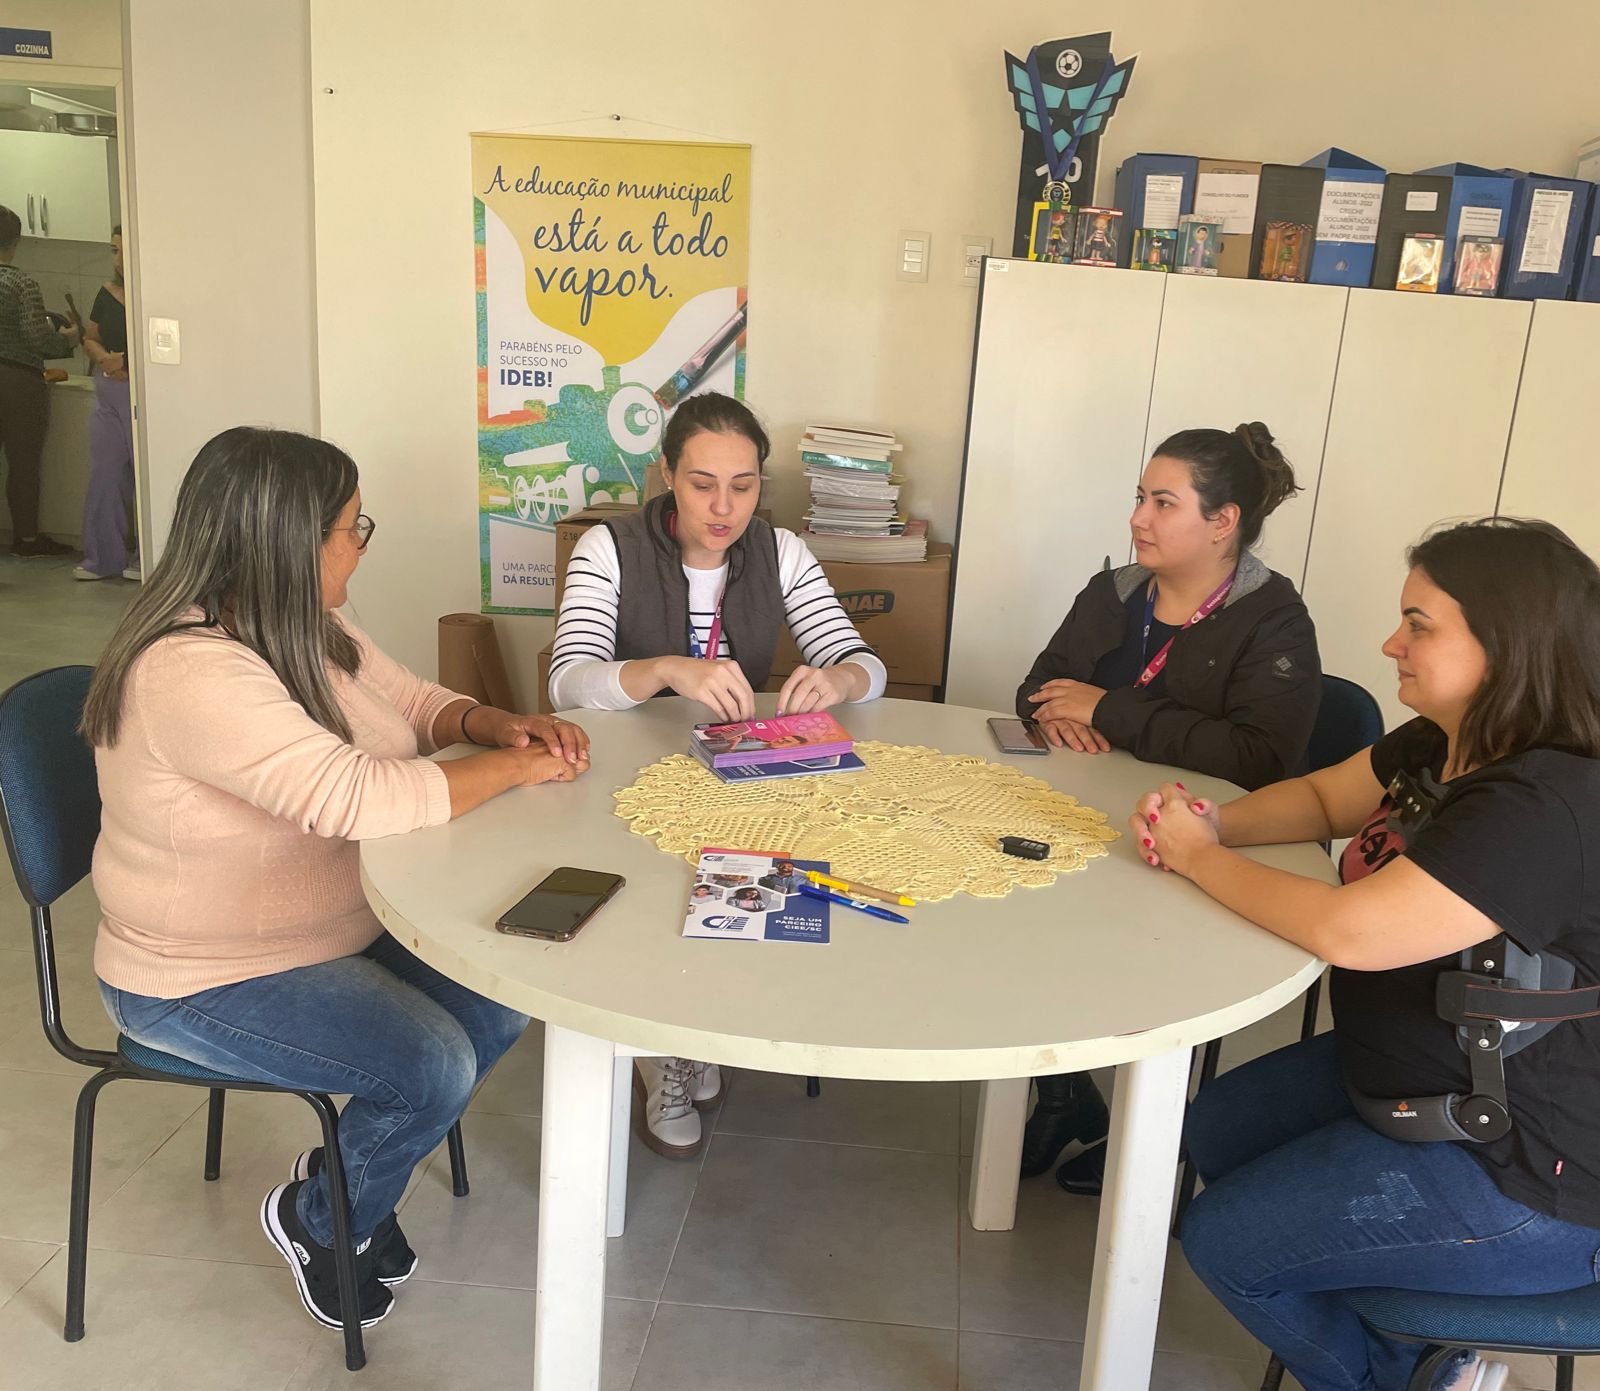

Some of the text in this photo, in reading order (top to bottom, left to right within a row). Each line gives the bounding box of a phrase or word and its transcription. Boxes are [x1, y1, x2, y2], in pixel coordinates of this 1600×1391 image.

[15, 44, 49, 55] COZINHA
[483, 165, 733, 216] A educação municipal
[533, 208, 728, 257] está a todo
[534, 263, 673, 326] vapor.
[500, 341, 582, 354] PARABÉNS PELO
[500, 355, 567, 367] SUCESSO NO
[500, 369, 552, 387] IDEB!
[502, 562, 556, 573] UMA PARC
[503, 574, 517, 584] DÁ
[295, 1246, 308, 1262] FILA
